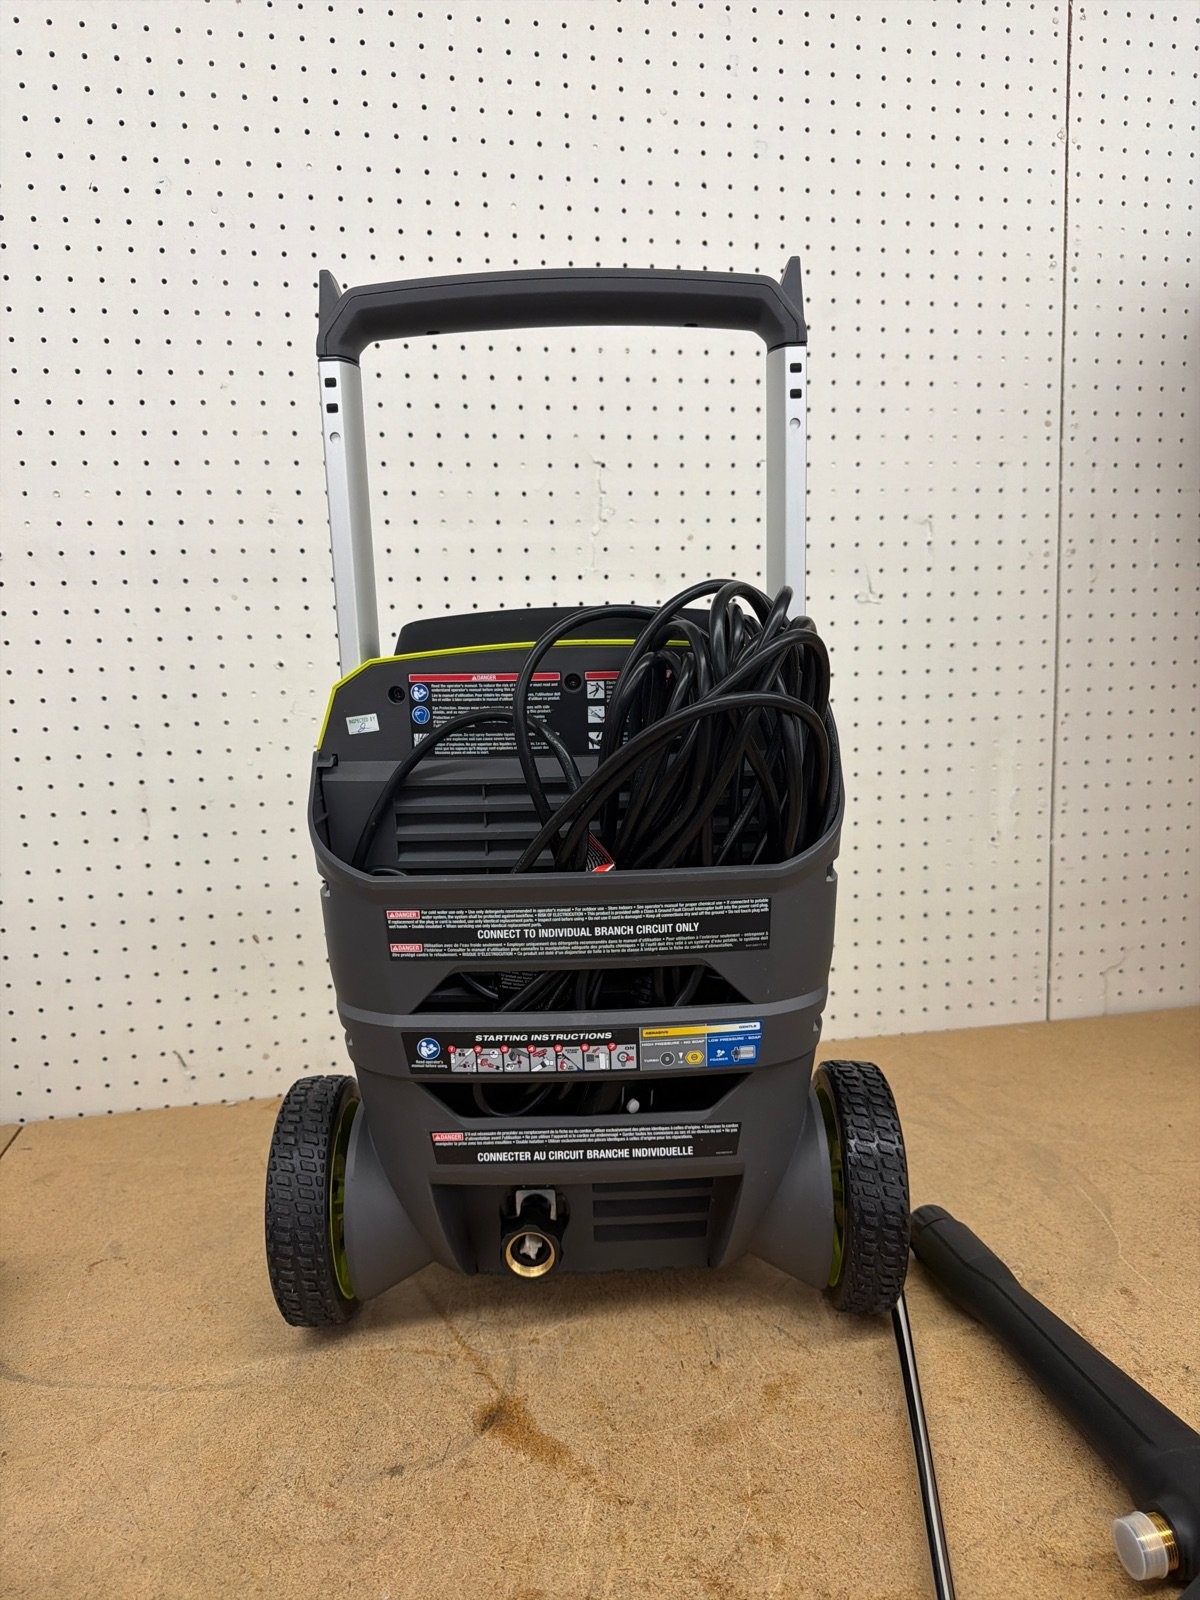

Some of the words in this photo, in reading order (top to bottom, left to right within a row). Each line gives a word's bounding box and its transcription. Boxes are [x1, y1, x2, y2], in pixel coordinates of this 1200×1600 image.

[477, 929, 520, 939] CONNECT
[523, 929, 535, 938] TO
[538, 927, 592, 938] INDIVIDUAL
[594, 925, 634, 936] BRANCH
[636, 924, 674, 934] CIRCUIT
[676, 922, 700, 932] ONLY
[475, 1034, 528, 1042] STARTING
[530, 1032, 612, 1041] INSTRUCTIONS
[477, 1152, 531, 1162] CONNECTER
[533, 1151, 546, 1160] AU
[548, 1150, 584, 1160] CIRCUIT
[586, 1148, 630, 1159] BRANCHE
[632, 1146, 694, 1157] INDIVIDUELLE
